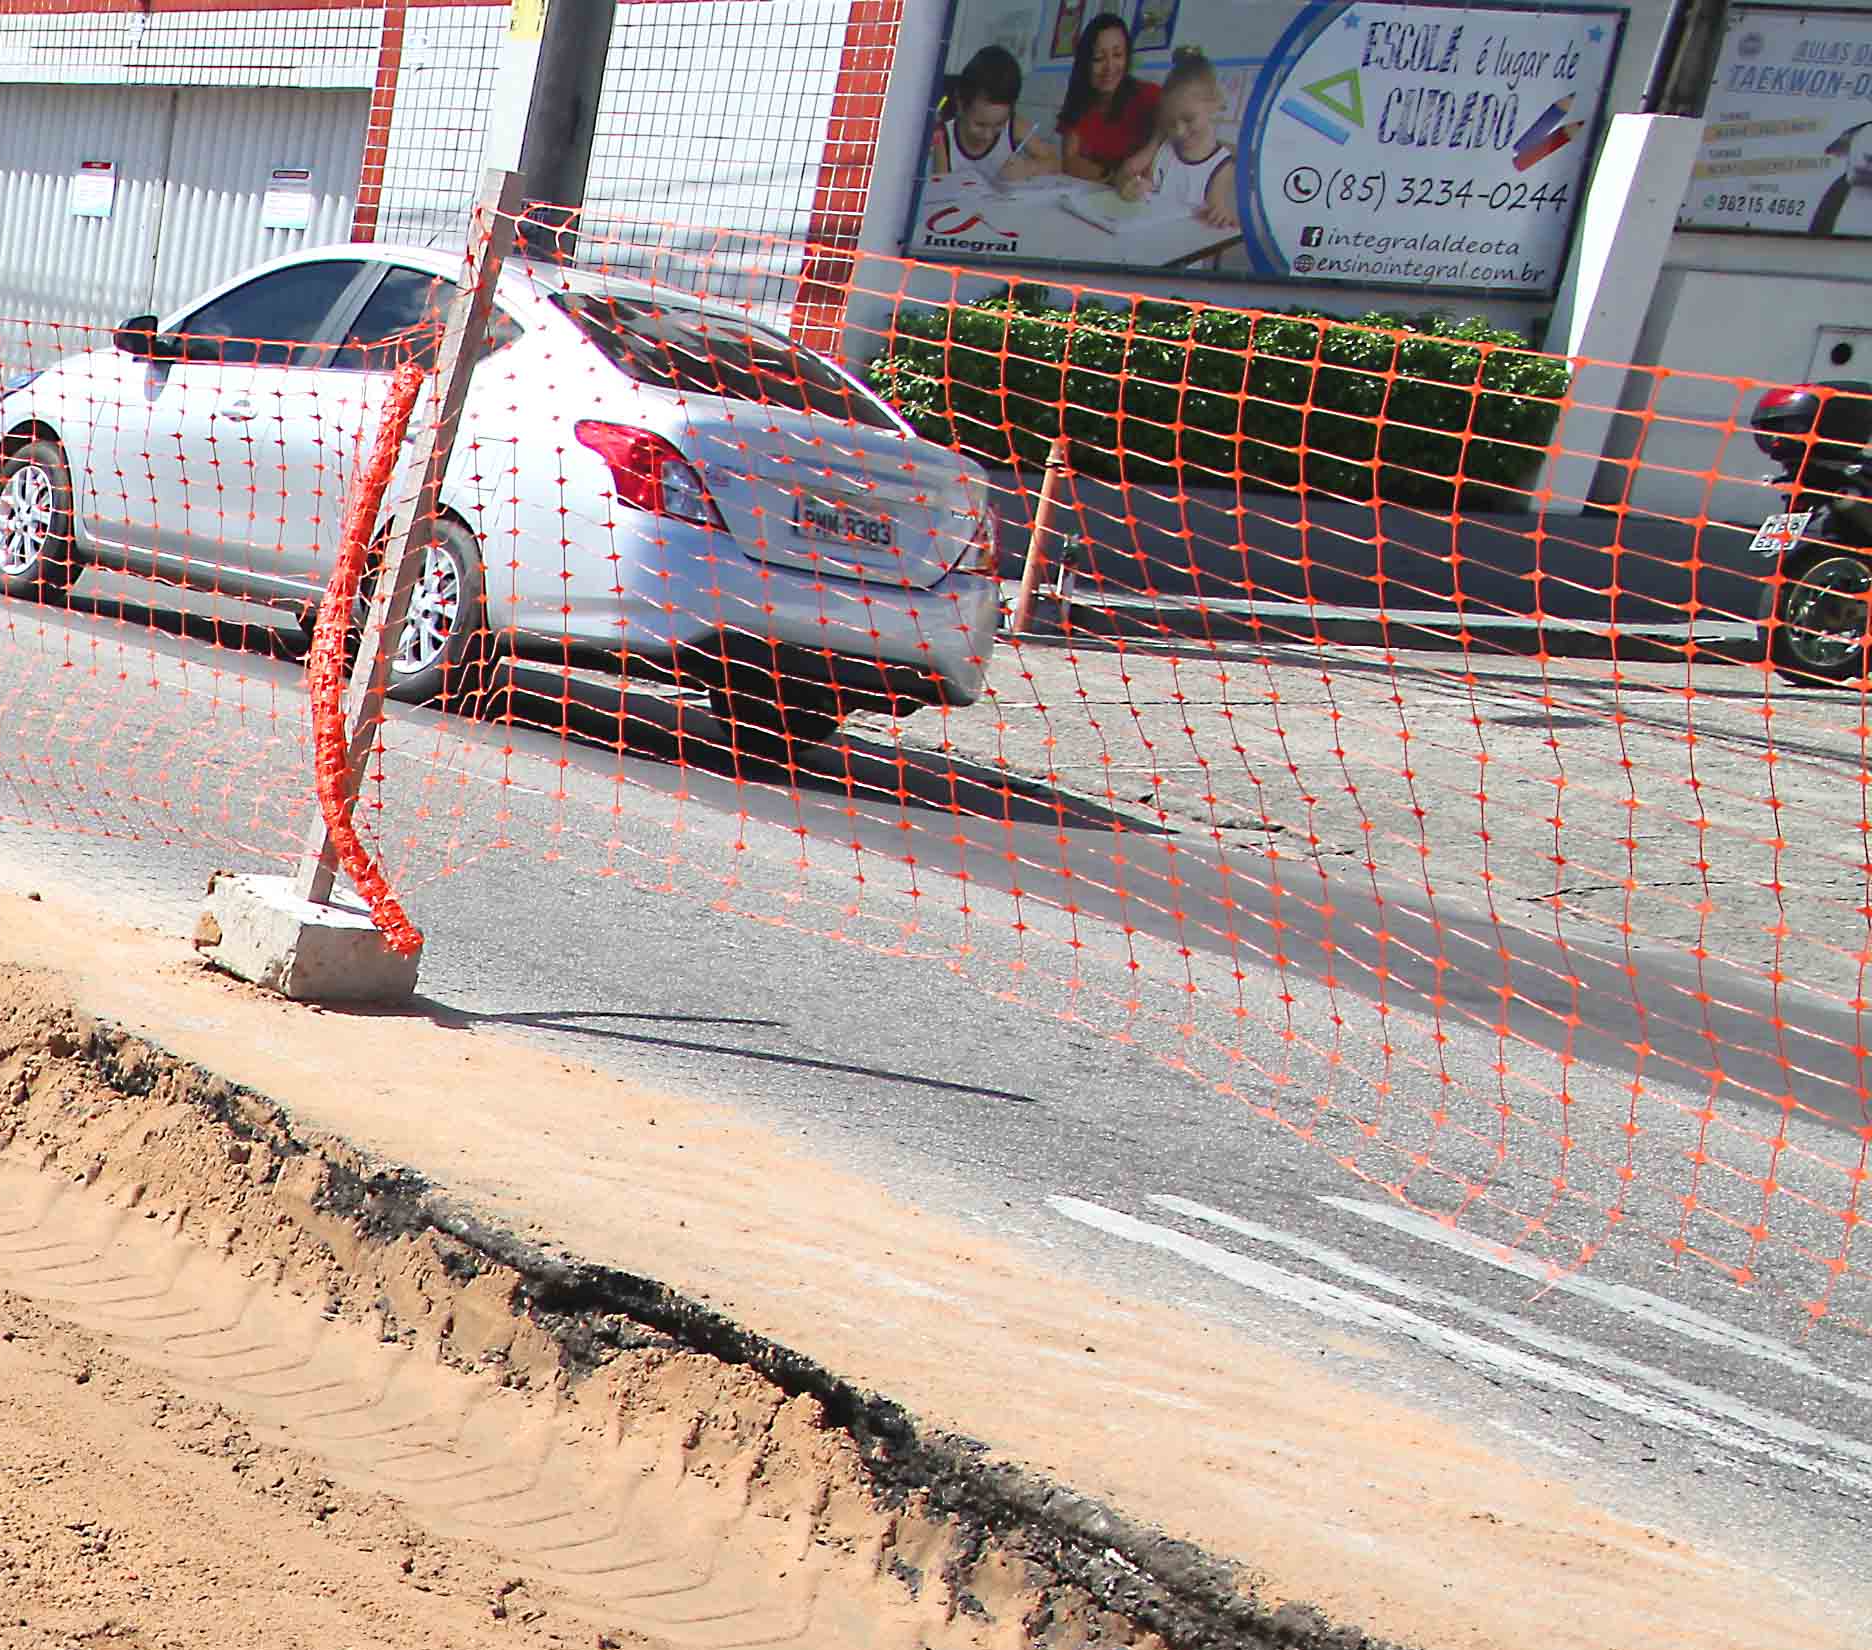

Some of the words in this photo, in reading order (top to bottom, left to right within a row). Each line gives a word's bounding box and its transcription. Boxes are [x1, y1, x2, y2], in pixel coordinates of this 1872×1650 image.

[1361, 21, 1464, 73] ESCOLA
[1475, 35, 1493, 74] é
[1493, 36, 1552, 90] lugar
[1552, 40, 1581, 80] de
[1728, 63, 1872, 97] TAEKWON-D
[1377, 87, 1520, 150] CUIDADO
[1326, 168, 1387, 211] (85)
[1396, 177, 1569, 213] 3234-0244
[924, 233, 1017, 252] Integral
[1327, 227, 1520, 256] integralaldeota
[1317, 254, 1545, 283] ensinointegral.com.br
